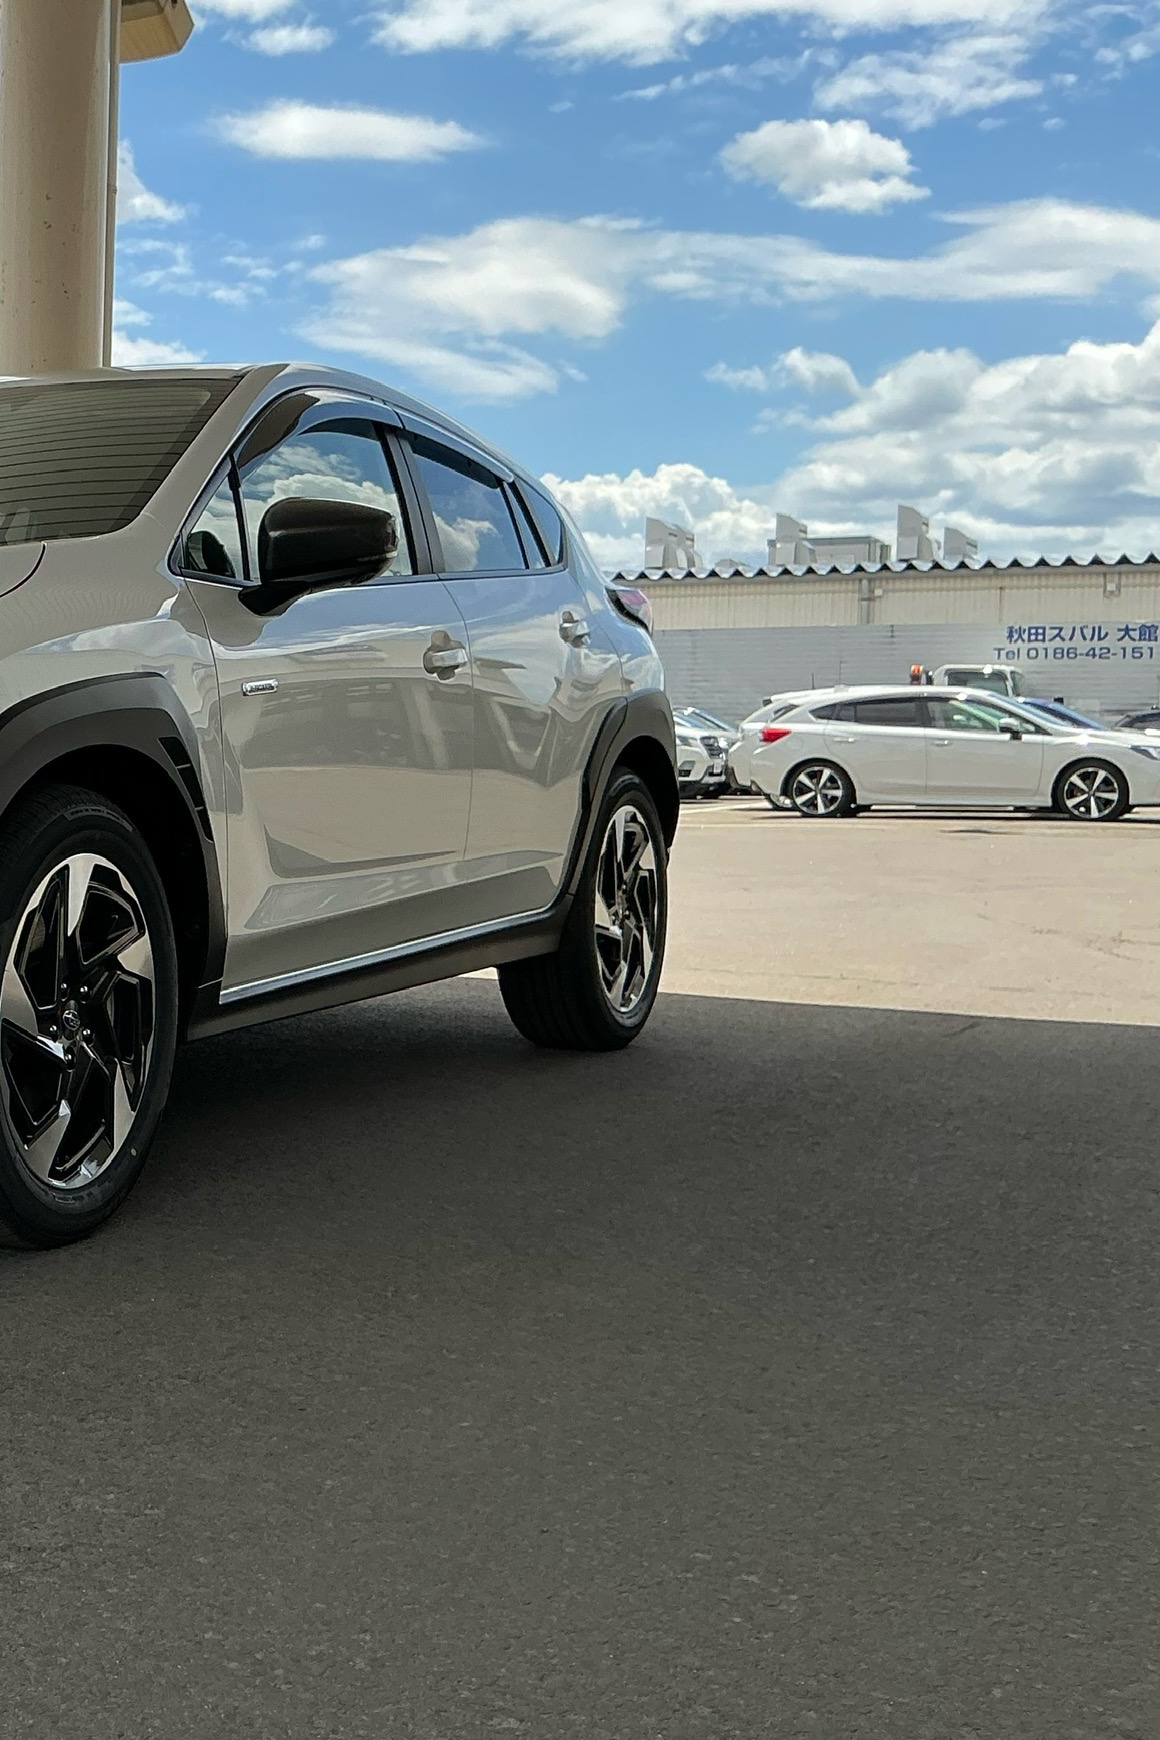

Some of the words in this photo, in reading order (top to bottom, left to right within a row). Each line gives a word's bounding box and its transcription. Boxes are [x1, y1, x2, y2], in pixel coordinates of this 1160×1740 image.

[1006, 624, 1109, 644] 秋田スバル
[993, 647, 1021, 661] Tel
